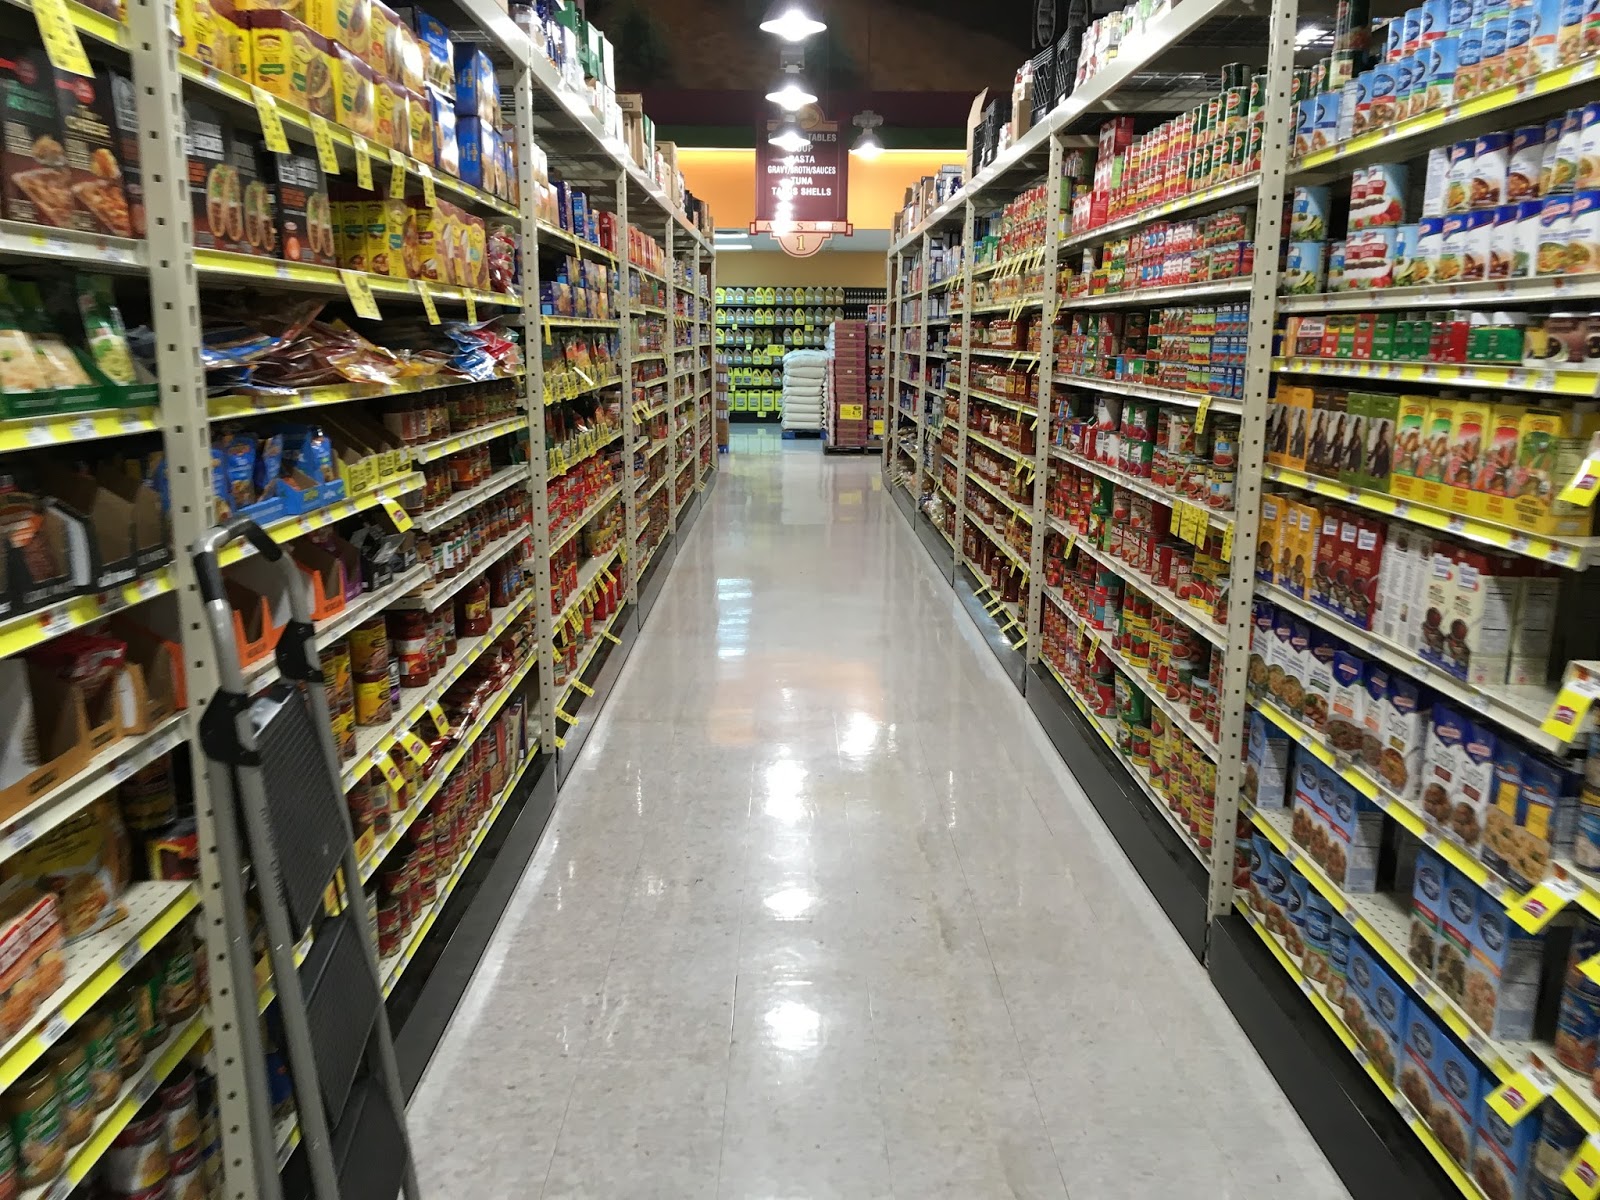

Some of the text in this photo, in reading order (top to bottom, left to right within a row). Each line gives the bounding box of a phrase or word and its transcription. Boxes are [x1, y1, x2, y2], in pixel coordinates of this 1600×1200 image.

[791, 177, 813, 185] TUNA
[771, 187, 831, 196] TAOS SHELLS
[765, 222, 838, 230] ASLE
[796, 235, 805, 250] 1
